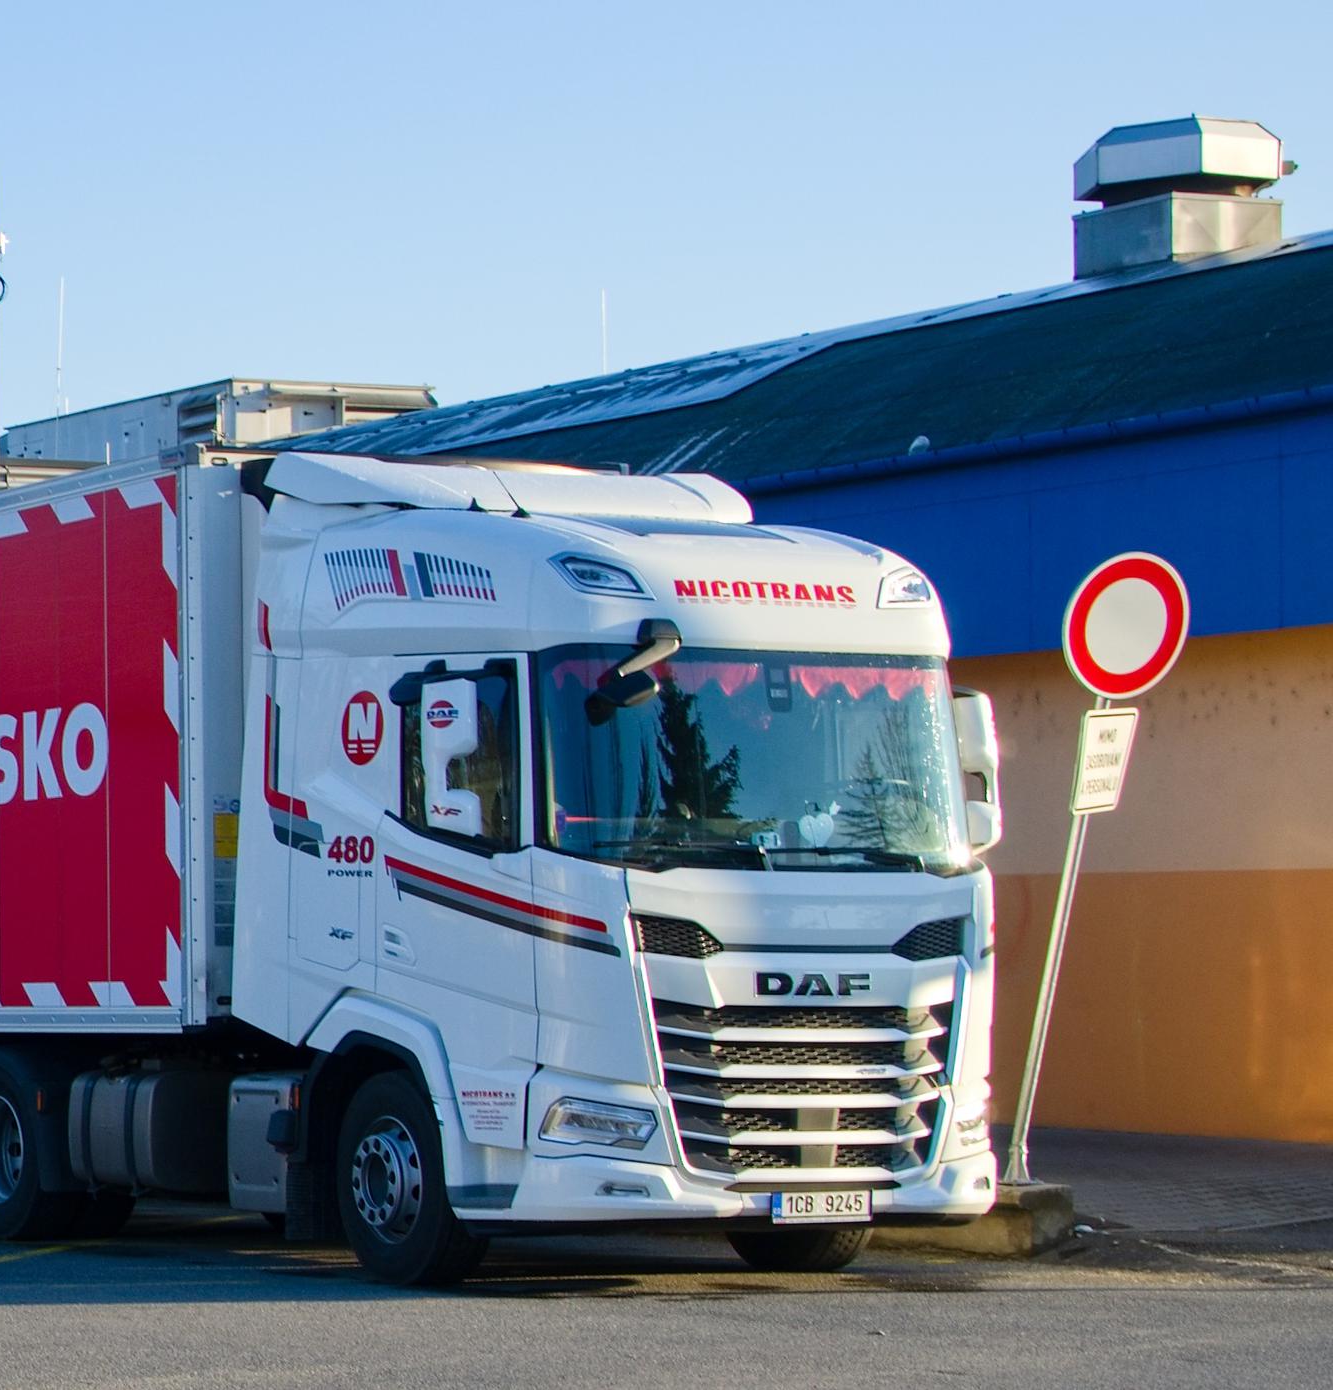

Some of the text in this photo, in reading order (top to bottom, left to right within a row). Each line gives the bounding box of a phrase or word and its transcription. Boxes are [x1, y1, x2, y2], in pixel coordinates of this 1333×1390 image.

[673, 579, 857, 608] NICOTRANS
[327, 835, 375, 864] 480
[327, 869, 374, 878] POWER
[756, 971, 870, 996] DAF
[786, 1195, 814, 1214] 1CB
[825, 1193, 863, 1212] 9245
